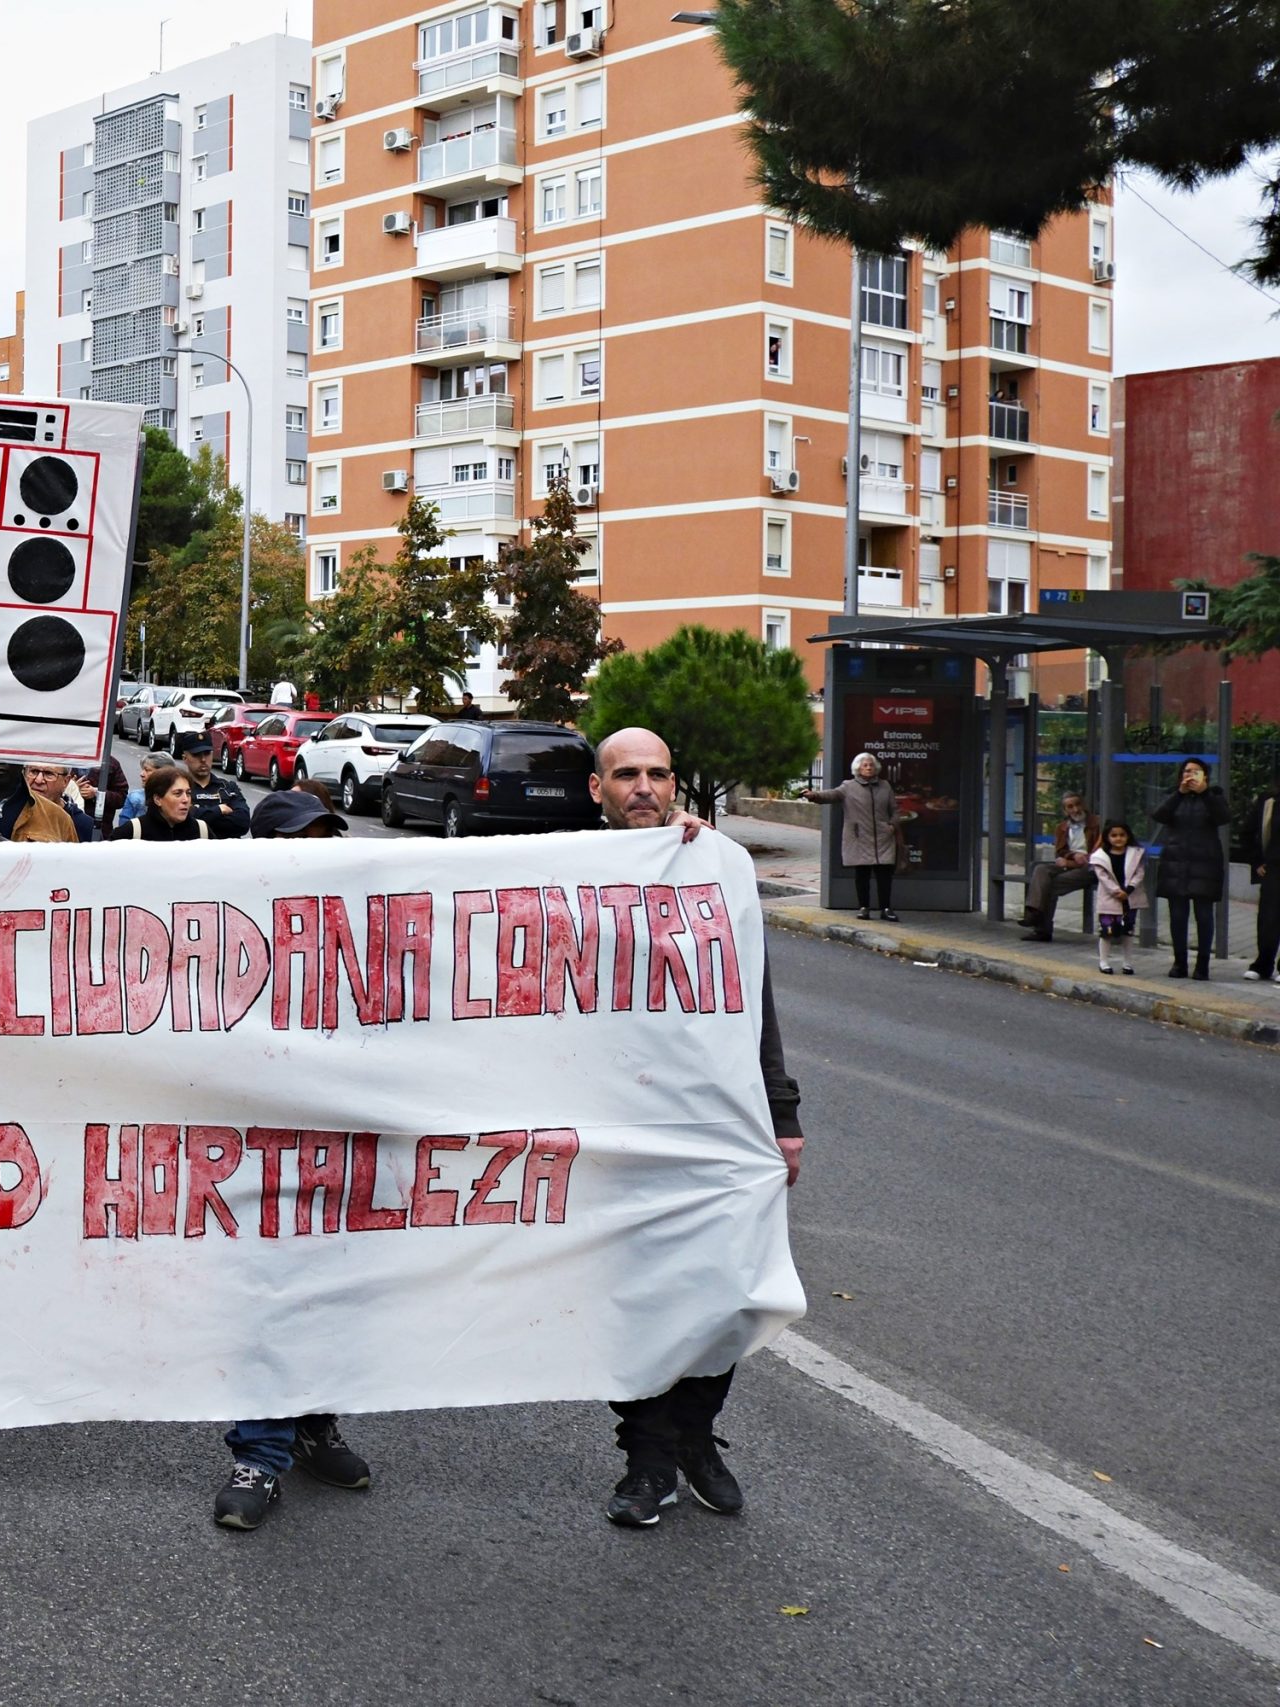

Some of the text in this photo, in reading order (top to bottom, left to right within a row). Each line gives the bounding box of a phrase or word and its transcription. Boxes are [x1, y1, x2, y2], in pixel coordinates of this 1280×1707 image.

[1056, 591, 1068, 601] 72
[878, 706, 929, 716] VIPS
[883, 731, 922, 740] Estamos
[886, 742, 940, 751] RESTAURANTE
[877, 751, 927, 760] que nunca
[452, 882, 744, 1021] CONTRA
[83, 1123, 580, 1240] HORTALEZA
